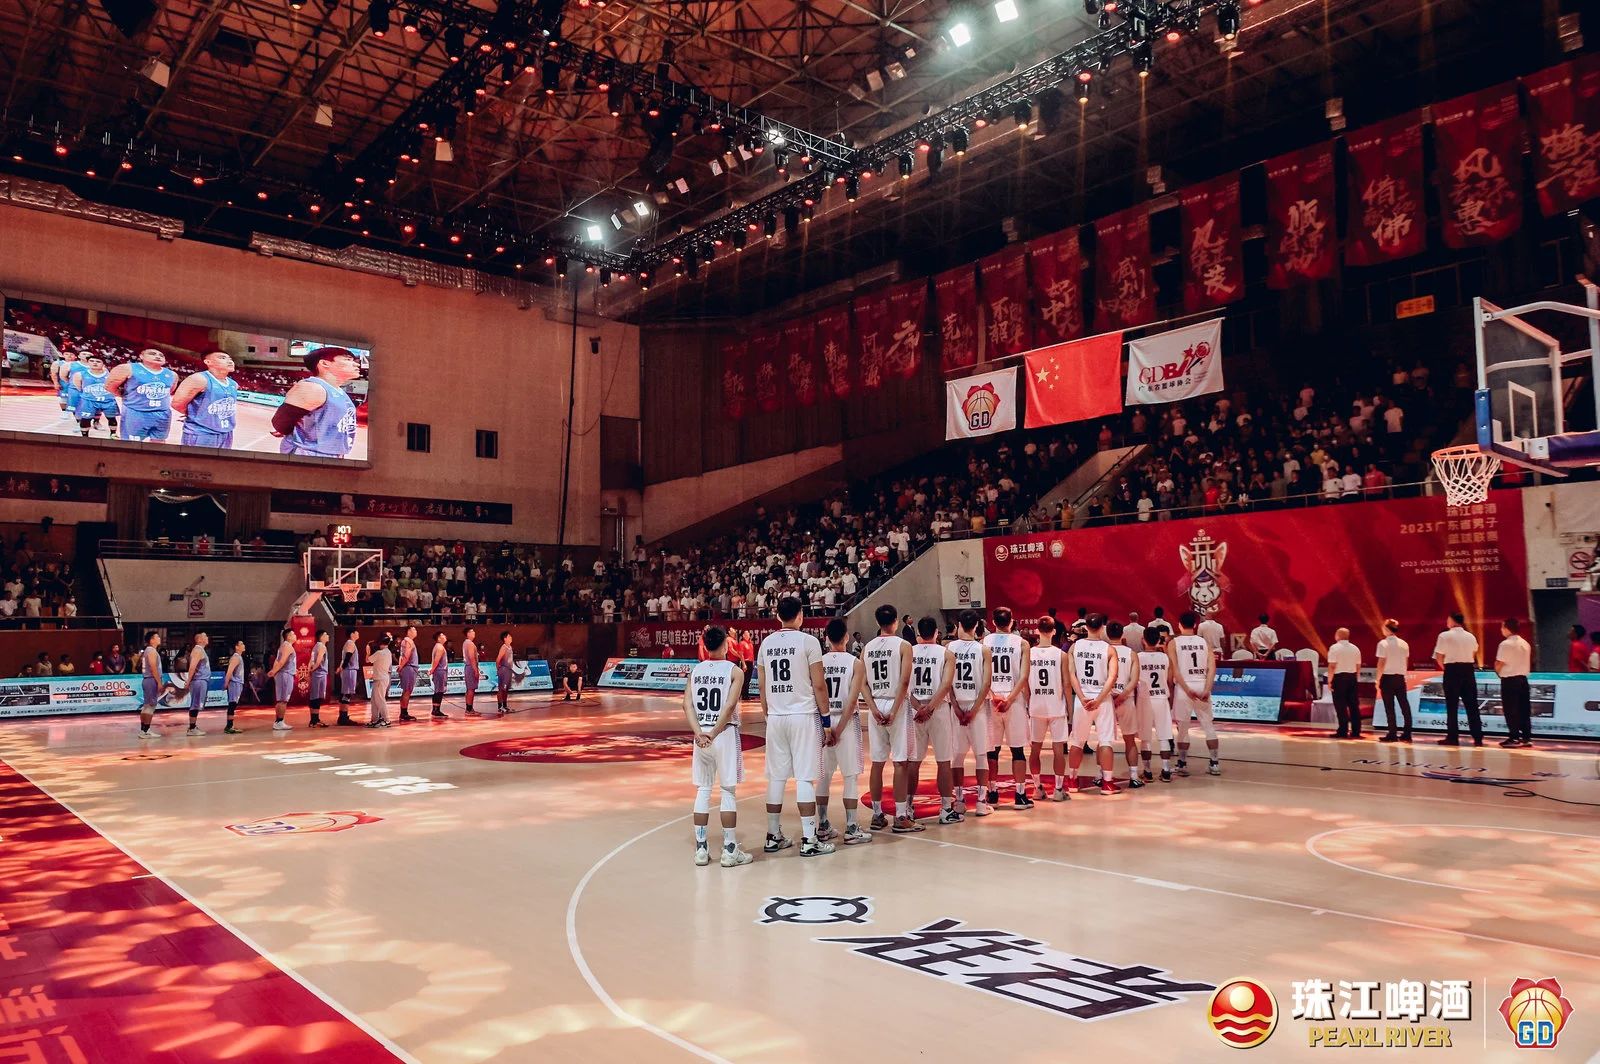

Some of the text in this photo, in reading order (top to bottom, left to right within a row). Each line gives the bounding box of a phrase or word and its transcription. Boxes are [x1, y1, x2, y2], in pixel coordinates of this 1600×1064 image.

[970, 411, 990, 428] GD
[333, 533, 348, 543] 24
[1473, 548, 1499, 556] RIVER
[1420, 558, 1471, 567] GUANGDONG
[1467, 564, 1500, 572] LEAGUE
[991, 655, 1011, 674] 10
[1084, 660, 1096, 678] 5
[1191, 652, 1198, 668] 1
[770, 658, 791, 682] 18
[872, 660, 888, 681] 15
[914, 666, 932, 686] 14
[955, 662, 973, 682] 12
[1038, 668, 1049, 687] 9
[825, 677, 841, 699] 17
[1149, 672, 1161, 688] 2
[697, 687, 721, 711] 30
